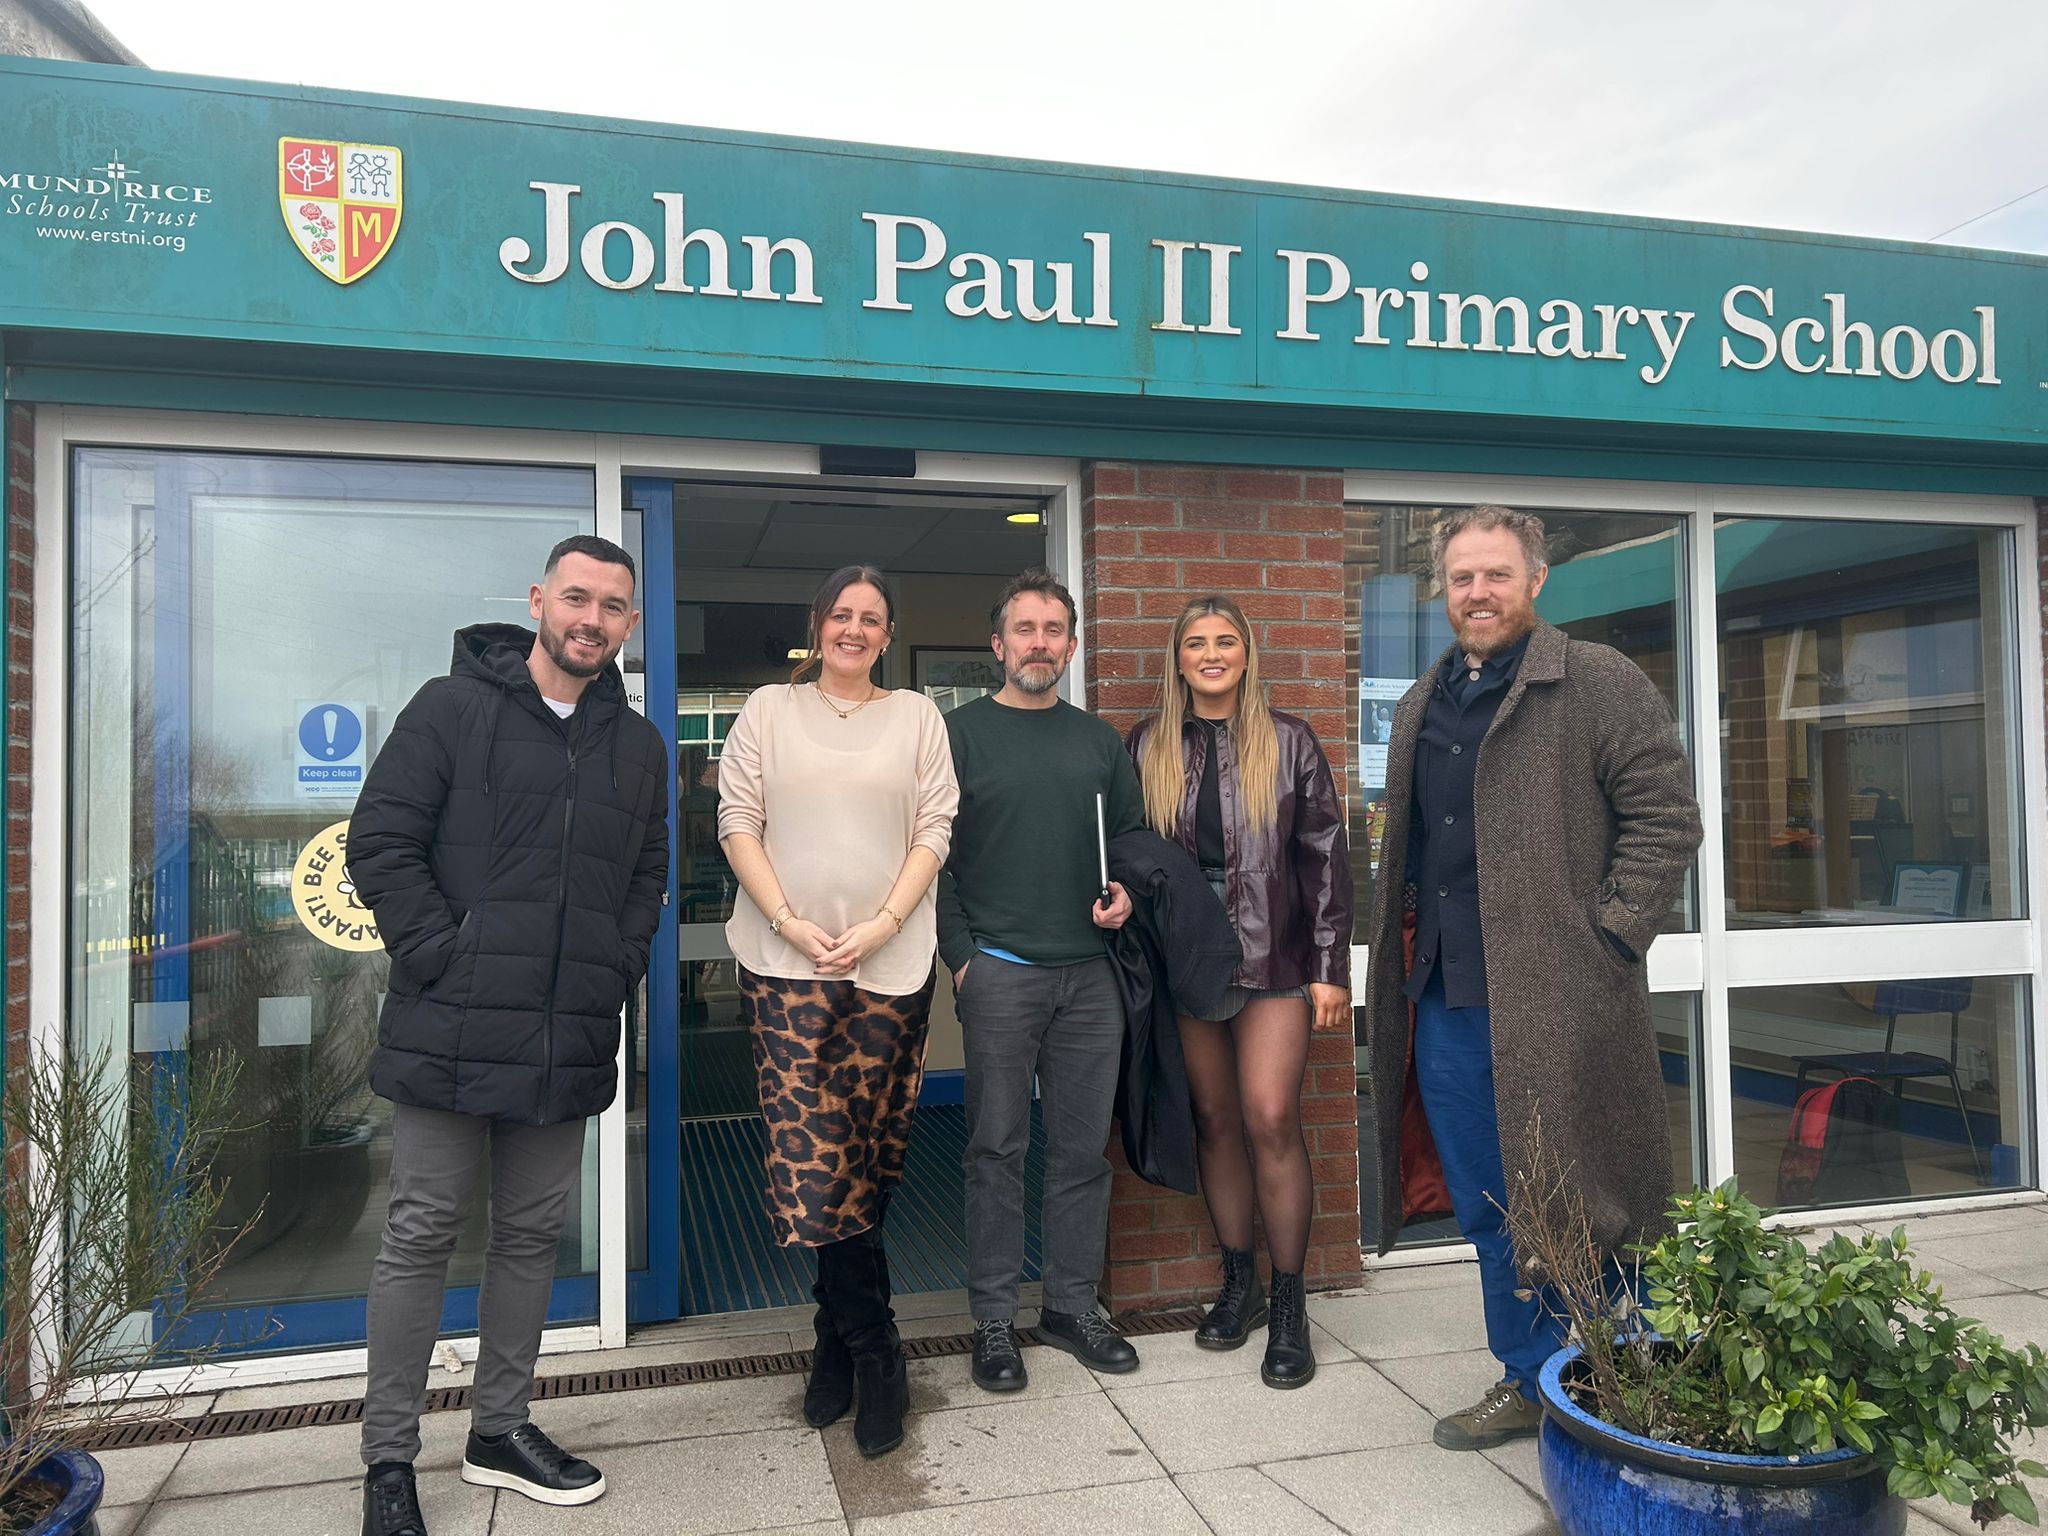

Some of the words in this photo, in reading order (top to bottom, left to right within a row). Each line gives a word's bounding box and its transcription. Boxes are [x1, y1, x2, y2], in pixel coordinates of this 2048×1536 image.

[123, 182, 213, 204] RICE
[7, 194, 110, 221] Schools
[124, 202, 199, 227] Trust
[36, 227, 186, 252] www.erstni.org
[499, 180, 824, 305] John
[861, 211, 1119, 328] Paul
[1150, 238, 1242, 336] II
[1275, 248, 1695, 386] Primary
[1719, 283, 2003, 386] School
[625, 692, 644, 704] tic
[302, 768, 329, 780] Keep
[331, 768, 358, 778] clear
[303, 846, 335, 887] BEE
[304, 894, 379, 941] APART!
